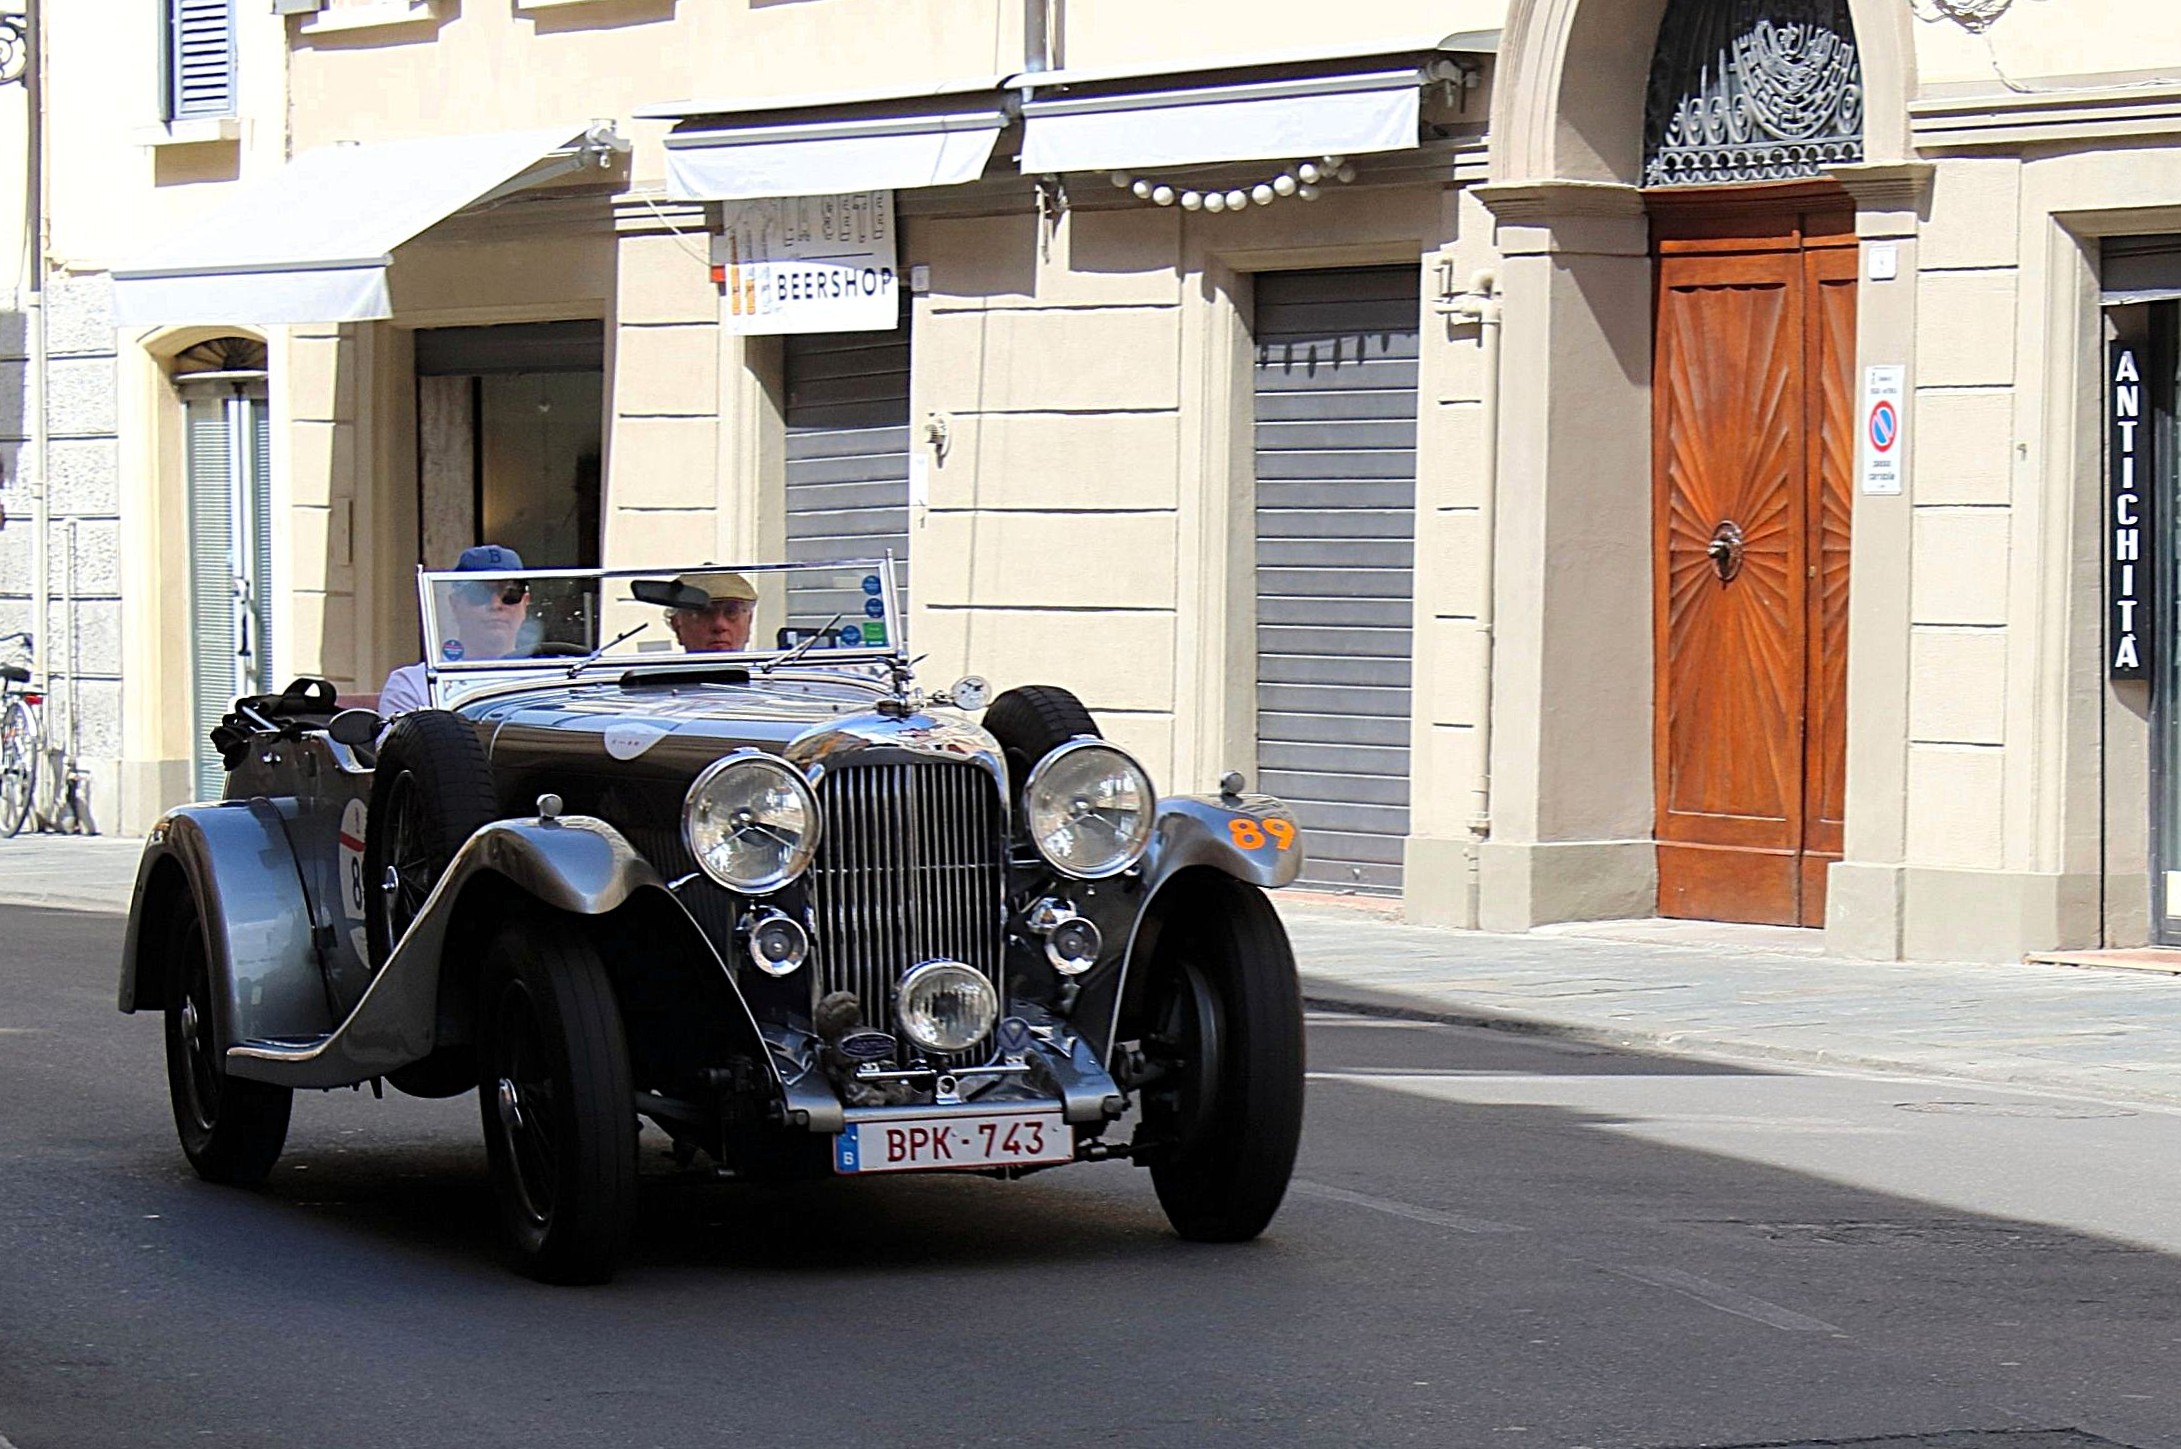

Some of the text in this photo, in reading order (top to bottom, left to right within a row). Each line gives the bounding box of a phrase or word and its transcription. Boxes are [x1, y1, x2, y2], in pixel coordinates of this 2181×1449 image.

[778, 267, 892, 300] BEERSHOP
[2115, 350, 2140, 667] ANTICHITÀ
[488, 549, 500, 563] B
[1228, 816, 1296, 850] 89
[351, 856, 363, 910] 8
[843, 1151, 854, 1165] B
[886, 1121, 1045, 1162] BPK-743
